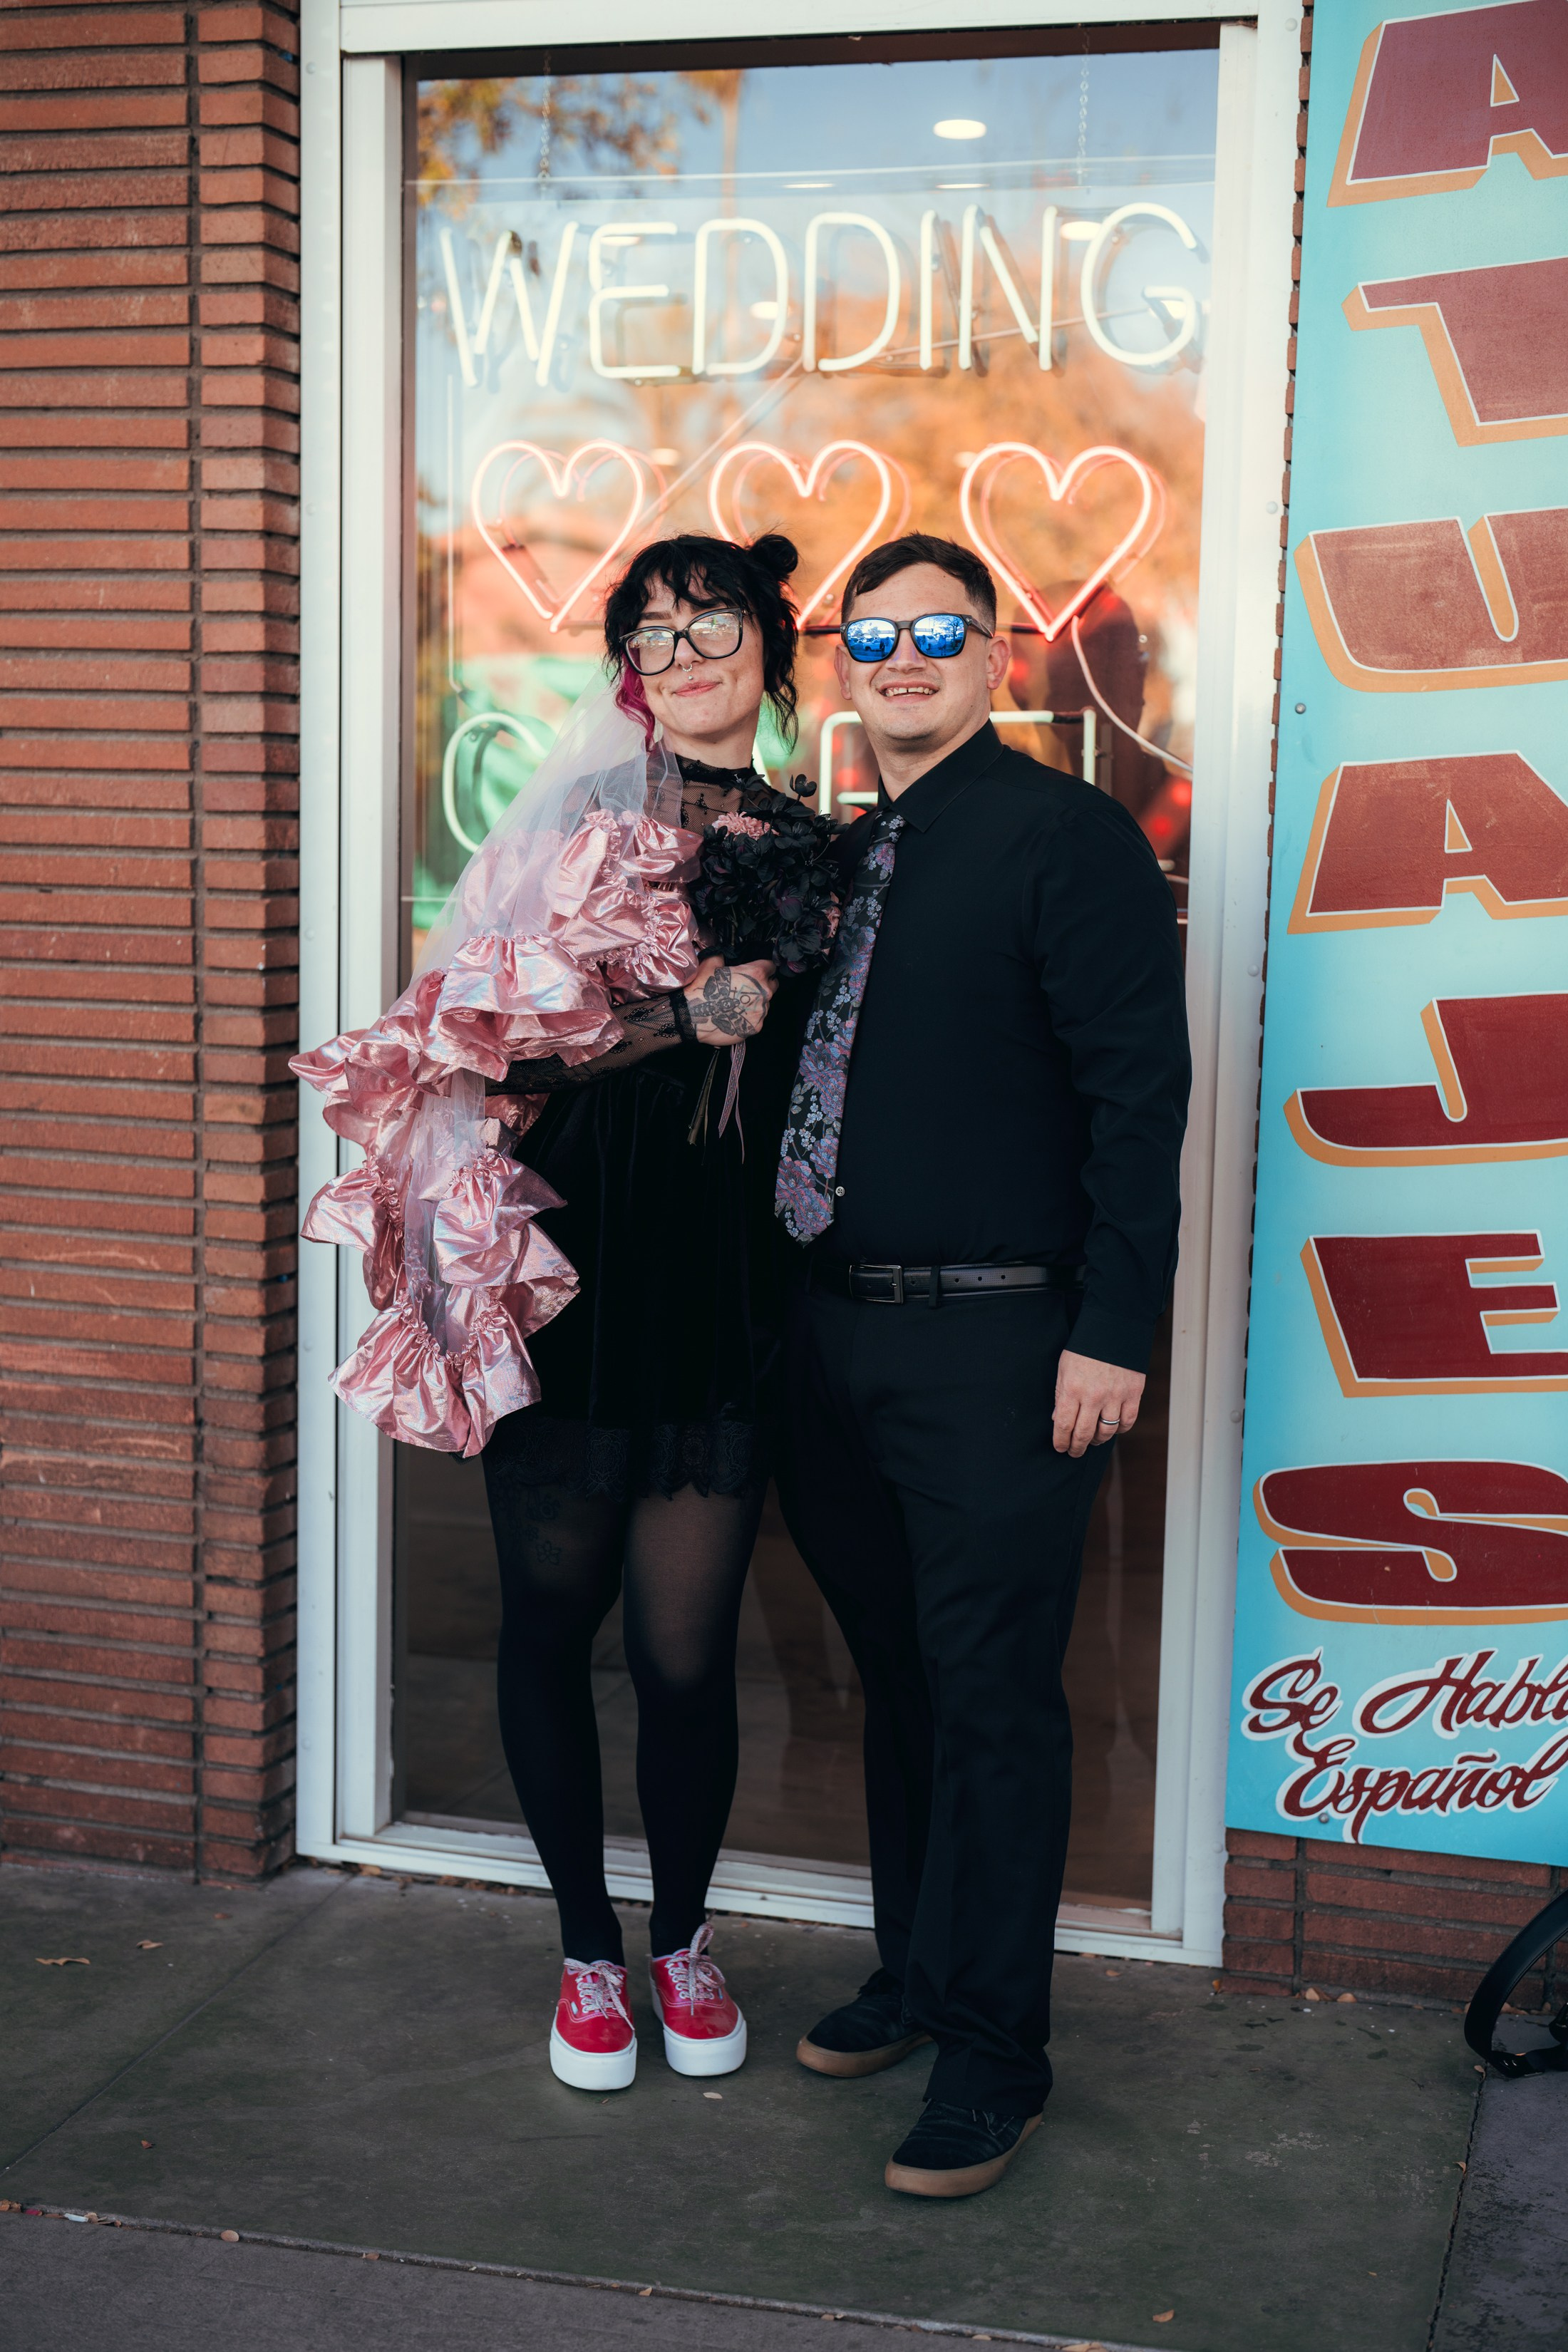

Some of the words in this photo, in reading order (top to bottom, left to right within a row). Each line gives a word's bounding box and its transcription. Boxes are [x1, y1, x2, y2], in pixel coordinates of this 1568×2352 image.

[439, 202, 1199, 387] WEDDING
[1242, 1646, 1343, 1741] Se
[1276, 1729, 1568, 1844] Español
